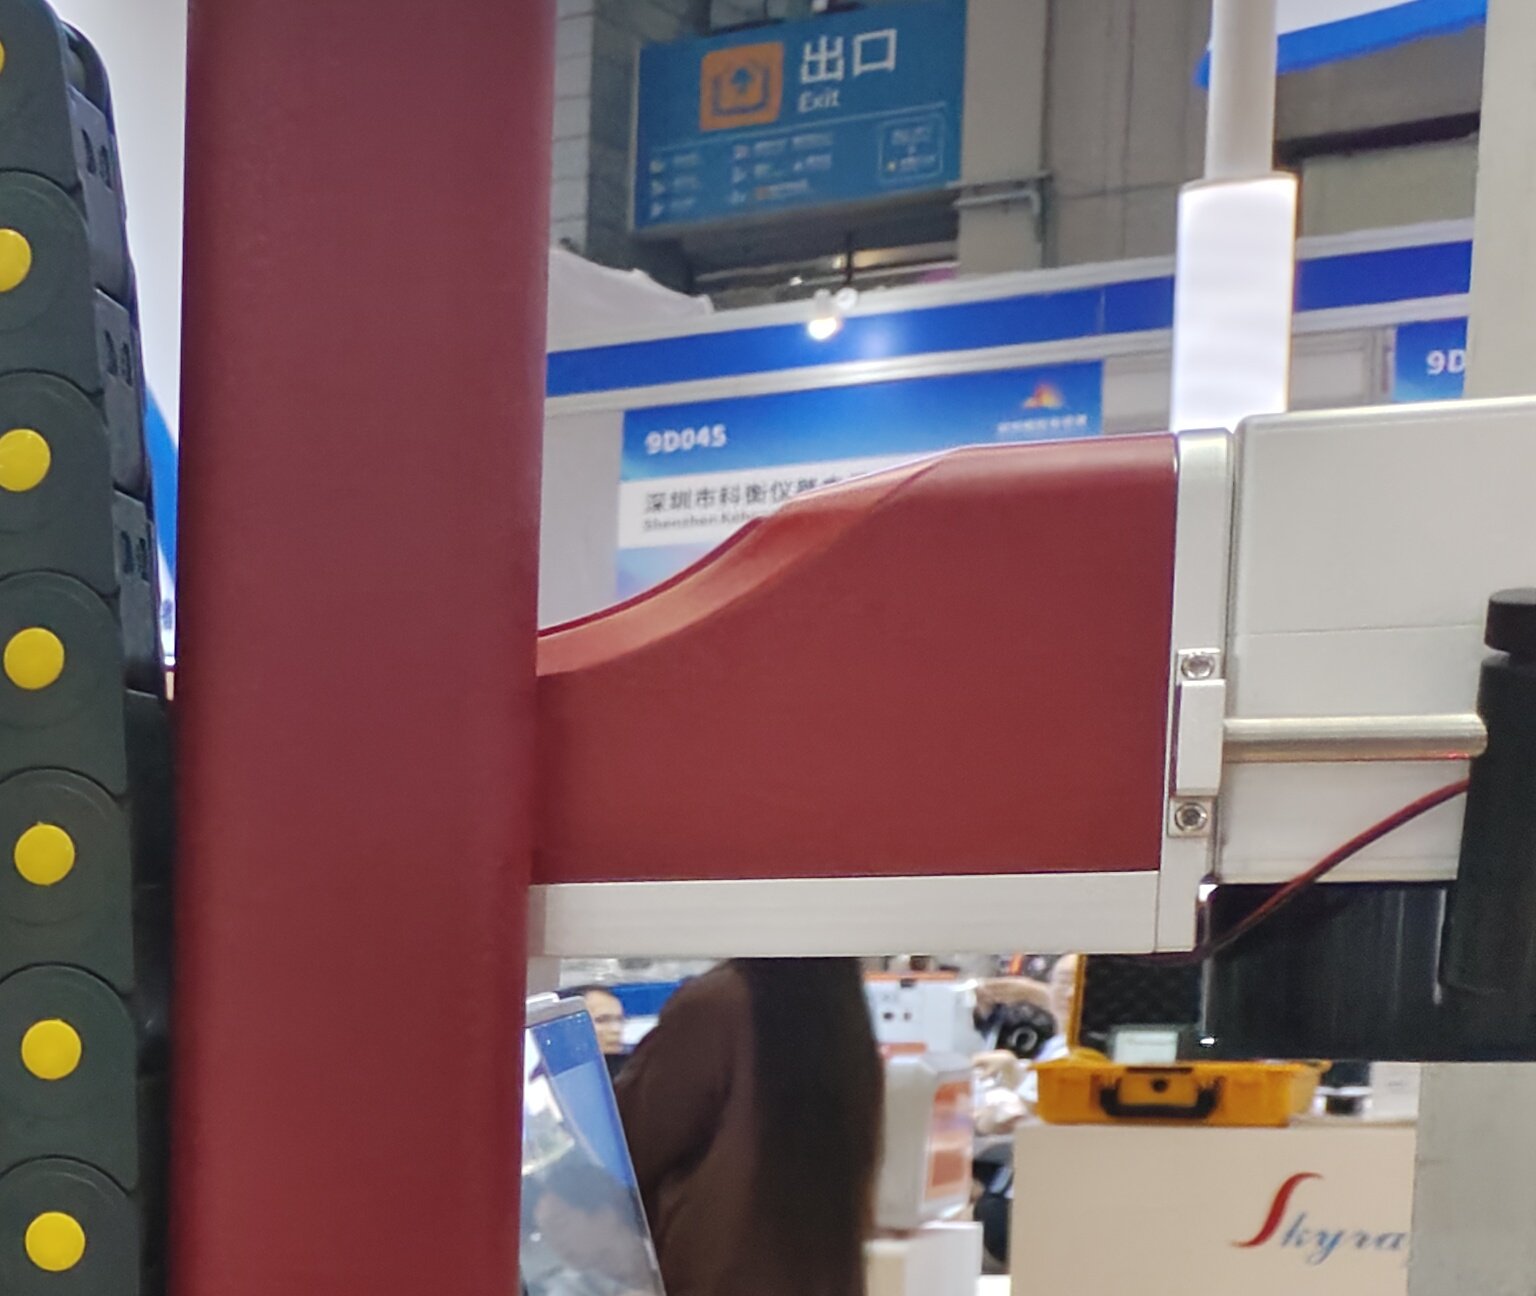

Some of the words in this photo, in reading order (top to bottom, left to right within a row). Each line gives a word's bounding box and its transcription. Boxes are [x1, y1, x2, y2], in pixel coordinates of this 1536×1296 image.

[800, 28, 897, 84] 出口
[797, 88, 840, 113] Exit
[644, 423, 727, 455] 9D045
[1228, 1171, 1410, 1268] Skyra
